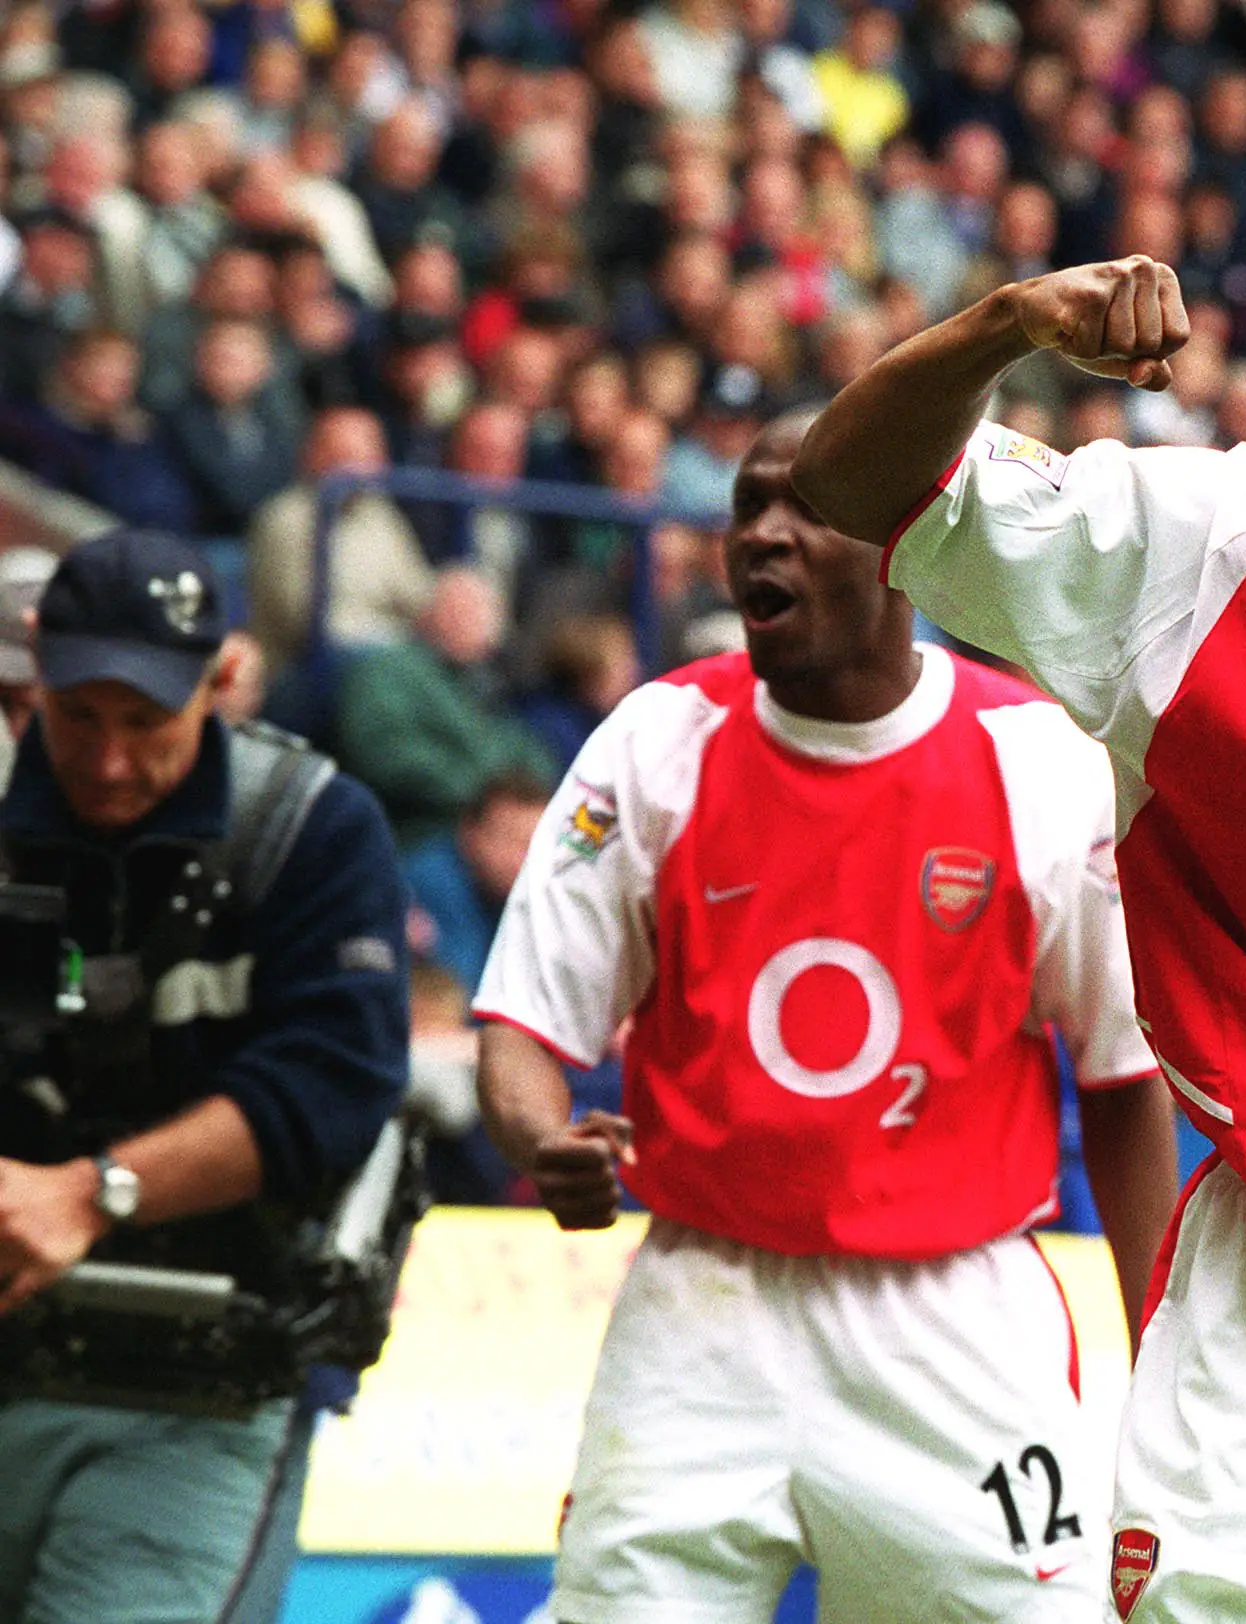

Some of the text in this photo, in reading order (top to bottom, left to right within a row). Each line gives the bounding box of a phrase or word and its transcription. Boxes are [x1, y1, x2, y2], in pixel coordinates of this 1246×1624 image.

[747, 937, 928, 1129] O2
[980, 1444, 1082, 1555] 12
[1118, 1544, 1150, 1561] Arsenal
